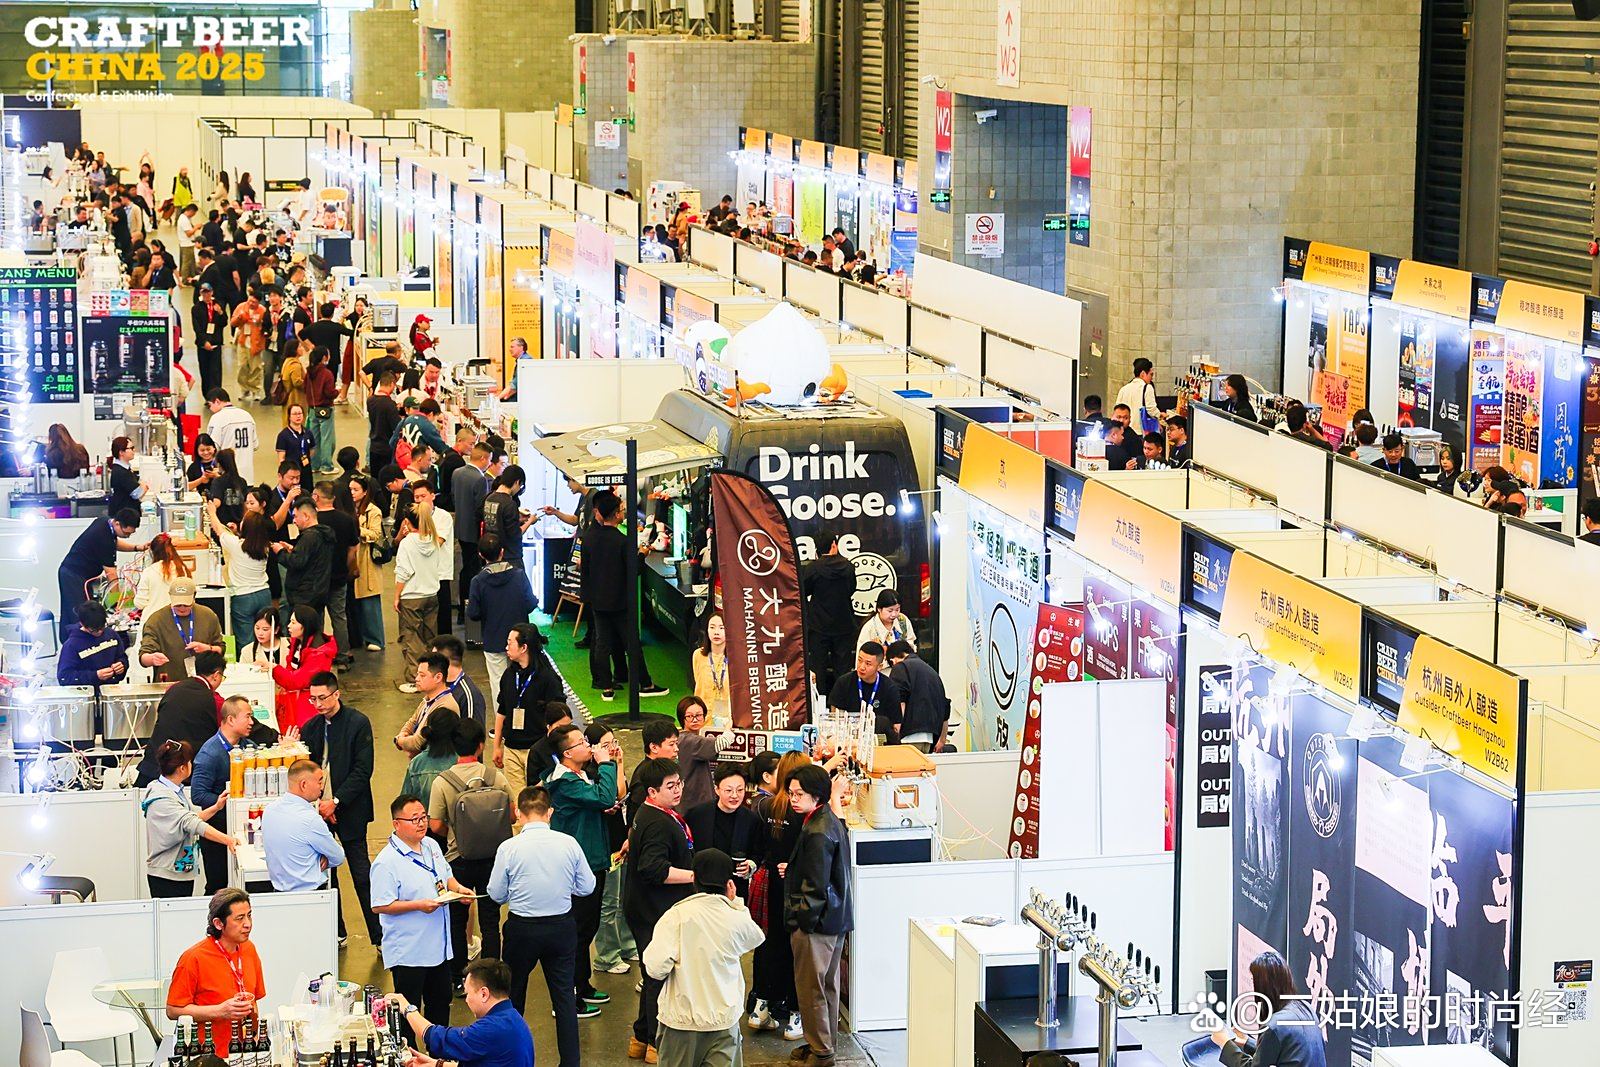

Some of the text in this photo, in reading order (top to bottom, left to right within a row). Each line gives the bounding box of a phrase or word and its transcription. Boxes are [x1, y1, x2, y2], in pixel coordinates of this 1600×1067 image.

[1000, 45, 1017, 77] W3
[936, 106, 950, 136] W2
[1071, 124, 1090, 158] W2
[972, 234, 998, 242] 禁止吸烟
[1075, 231, 1084, 241] Gate
[36, 269, 75, 277] MENU
[42, 384, 73, 392] 不一样的
[235, 428, 249, 448] 90
[759, 440, 870, 482] Drink
[587, 475, 624, 485] GOOSE IS HERE
[1116, 517, 1141, 545] 大九酿造
[553, 563, 567, 571] Dri
[1193, 552, 1210, 567] CRAFT
[1193, 561, 1210, 579] BEER
[1193, 573, 1208, 588] CHINA
[1260, 588, 1320, 635] 杭州局外人酿造
[742, 587, 758, 663] MAHANINE
[1254, 611, 1326, 656] Outsider Craftbeer Hangzhou
[759, 587, 790, 730] 大九酿造
[1376, 641, 1398, 660] CRAFT
[1376, 652, 1398, 674] BEER
[1376, 665, 1396, 682] CHINA
[1333, 670, 1354, 690] W2B62
[1422, 665, 1499, 725] 杭州局外人酿造
[1414, 691, 1507, 749] Outsider Craftbeer Hangzhou
[1484, 748, 1510, 774] W2B62
